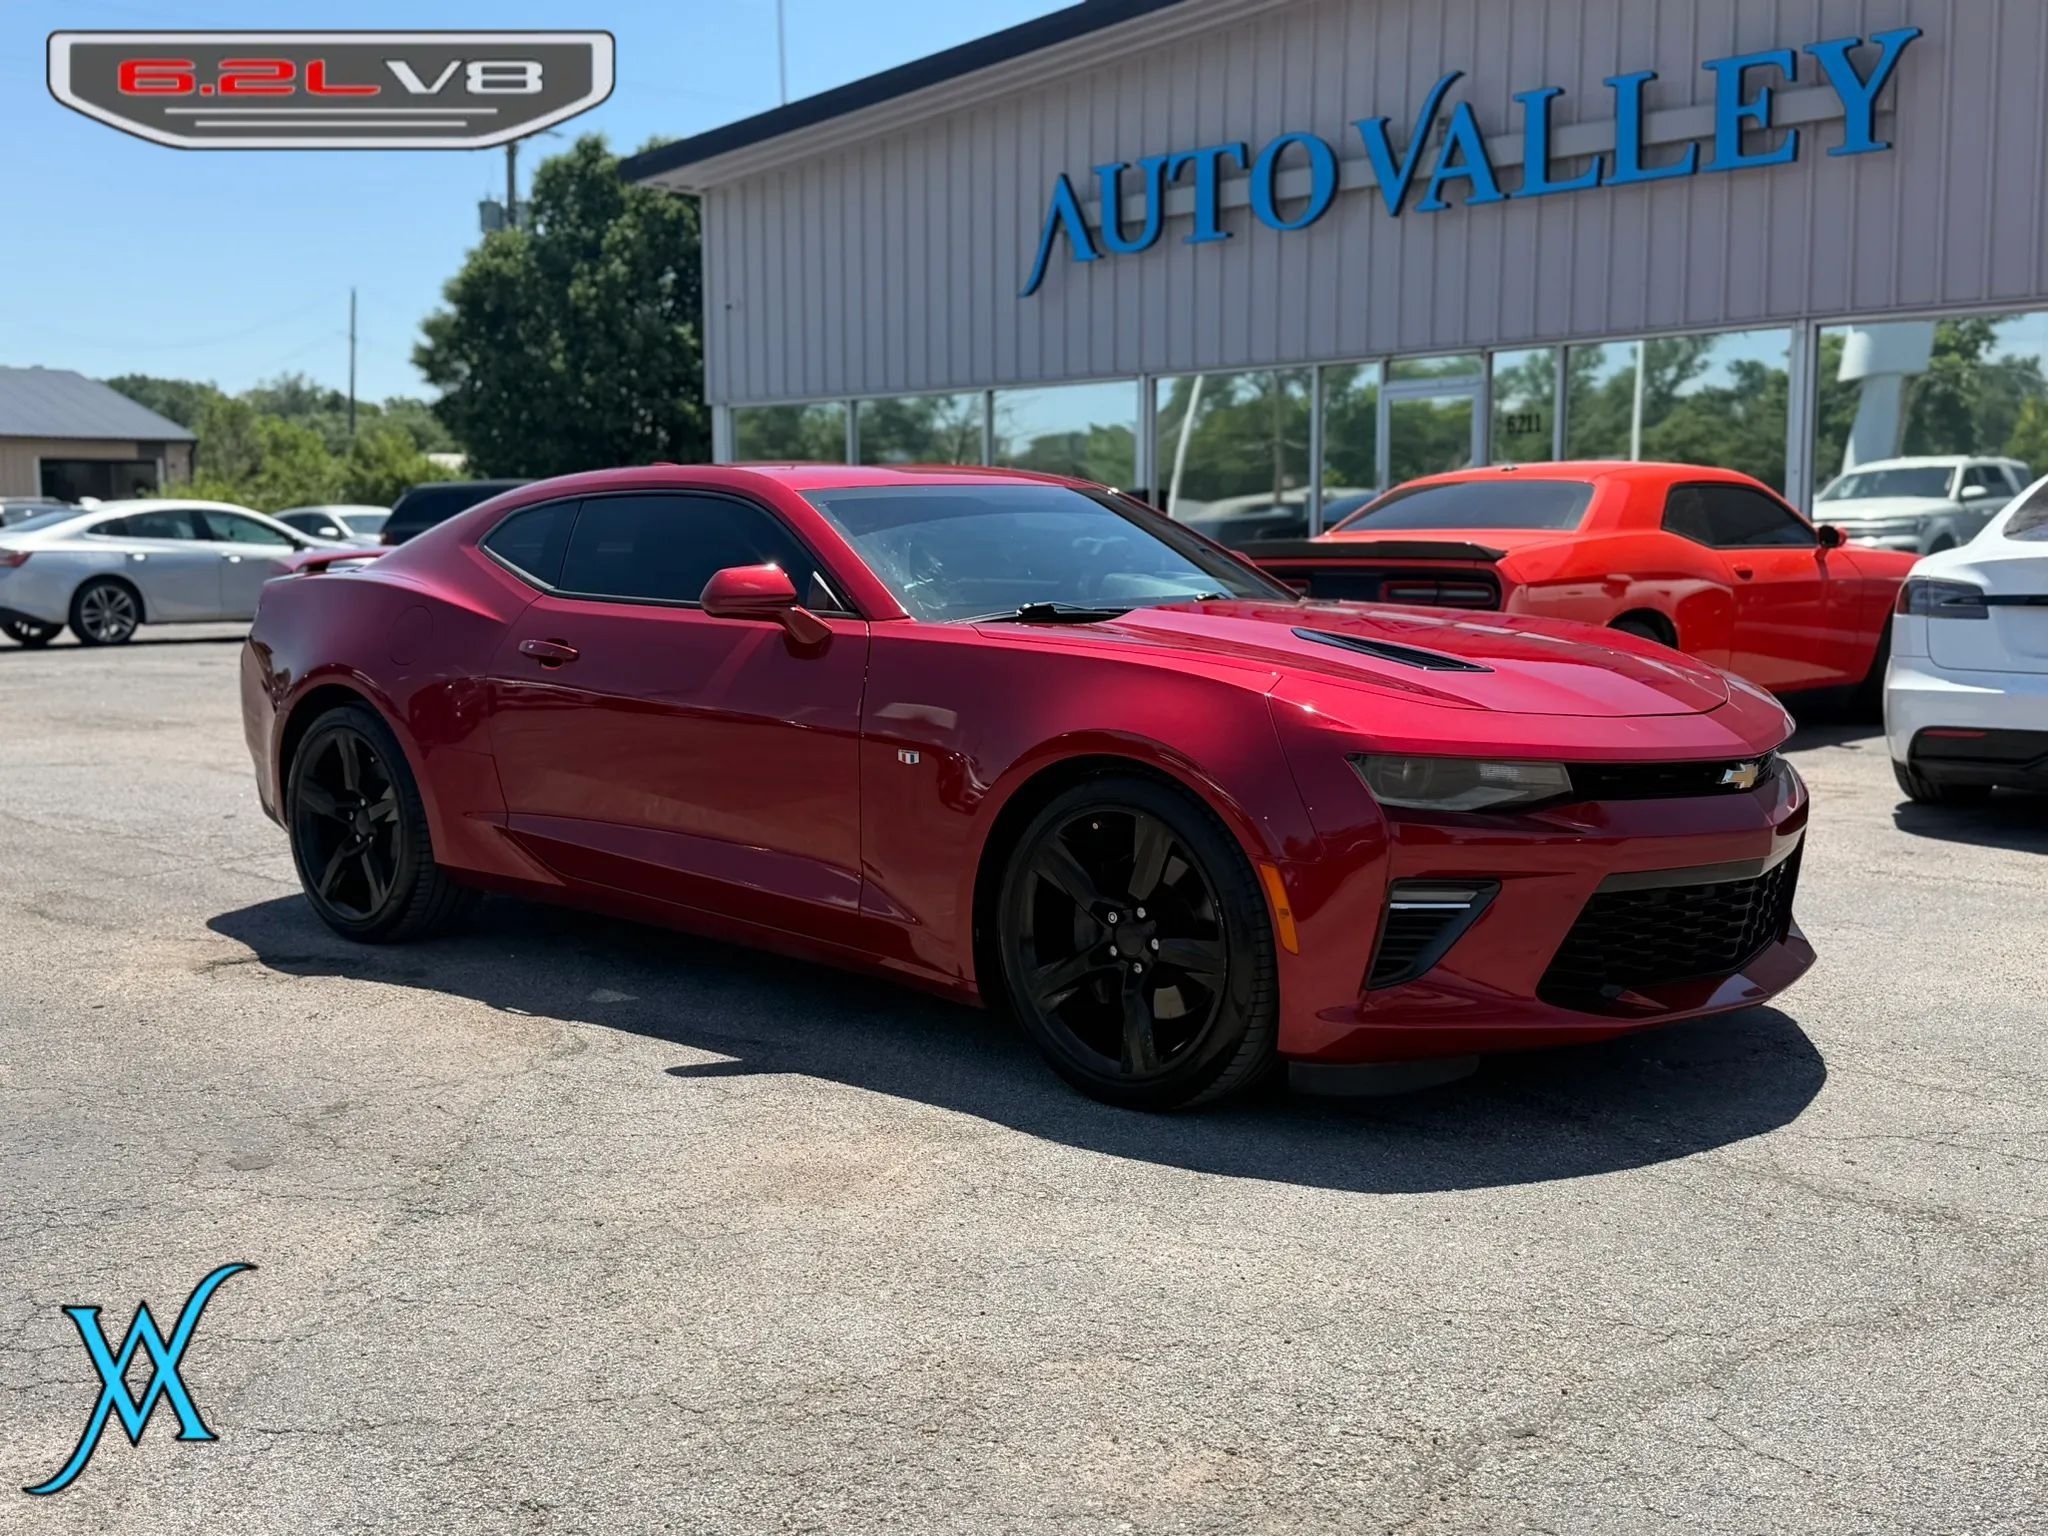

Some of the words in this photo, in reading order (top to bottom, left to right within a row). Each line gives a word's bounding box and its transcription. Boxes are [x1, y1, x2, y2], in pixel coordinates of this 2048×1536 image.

[1018, 130, 1340, 299] AUTO
[1349, 26, 1924, 217] VALLEY
[1507, 413, 1541, 433] 6211
